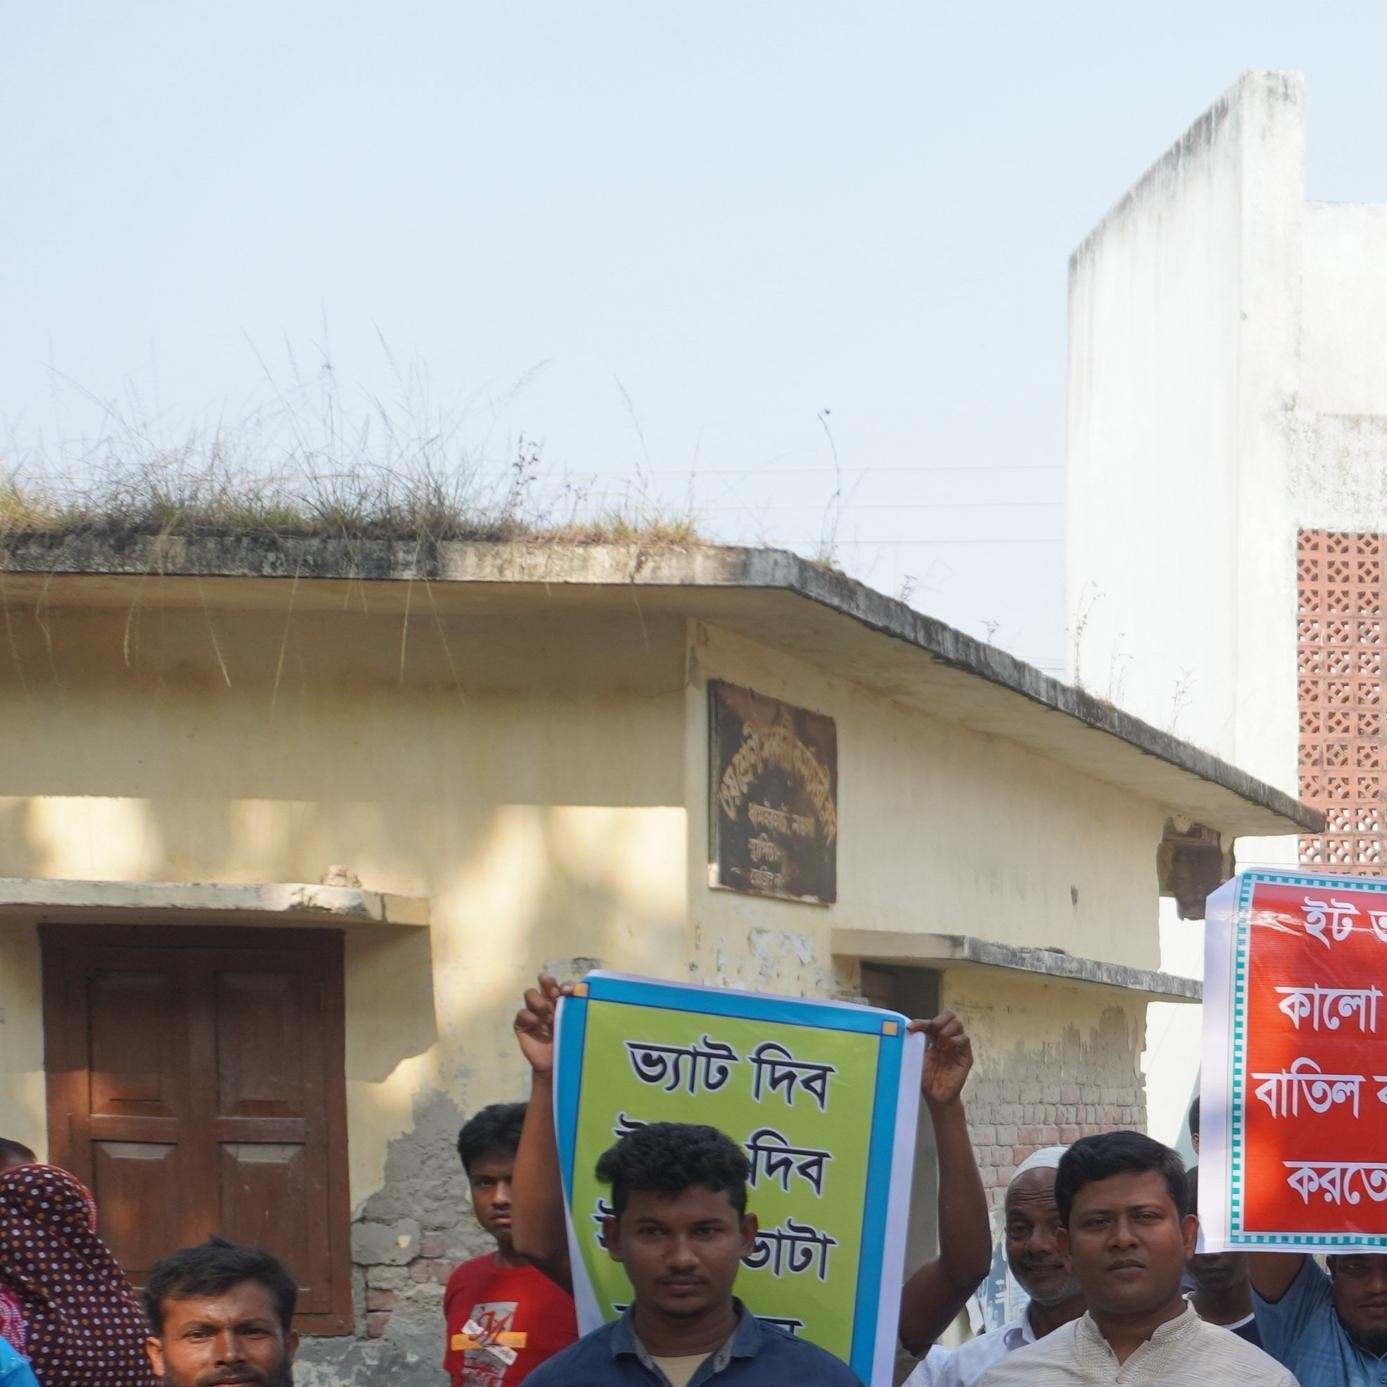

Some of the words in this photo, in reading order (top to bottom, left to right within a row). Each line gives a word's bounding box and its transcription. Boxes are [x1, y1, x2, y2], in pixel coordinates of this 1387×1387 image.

[1301, 896, 1359, 952] ইট
[1274, 984, 1384, 1036] কালো
[624, 1033, 739, 1095] ভ্যাট
[748, 1042, 837, 1112] দিব
[1251, 1056, 1366, 1123] বাতিল
[743, 1128, 832, 1195] দিব
